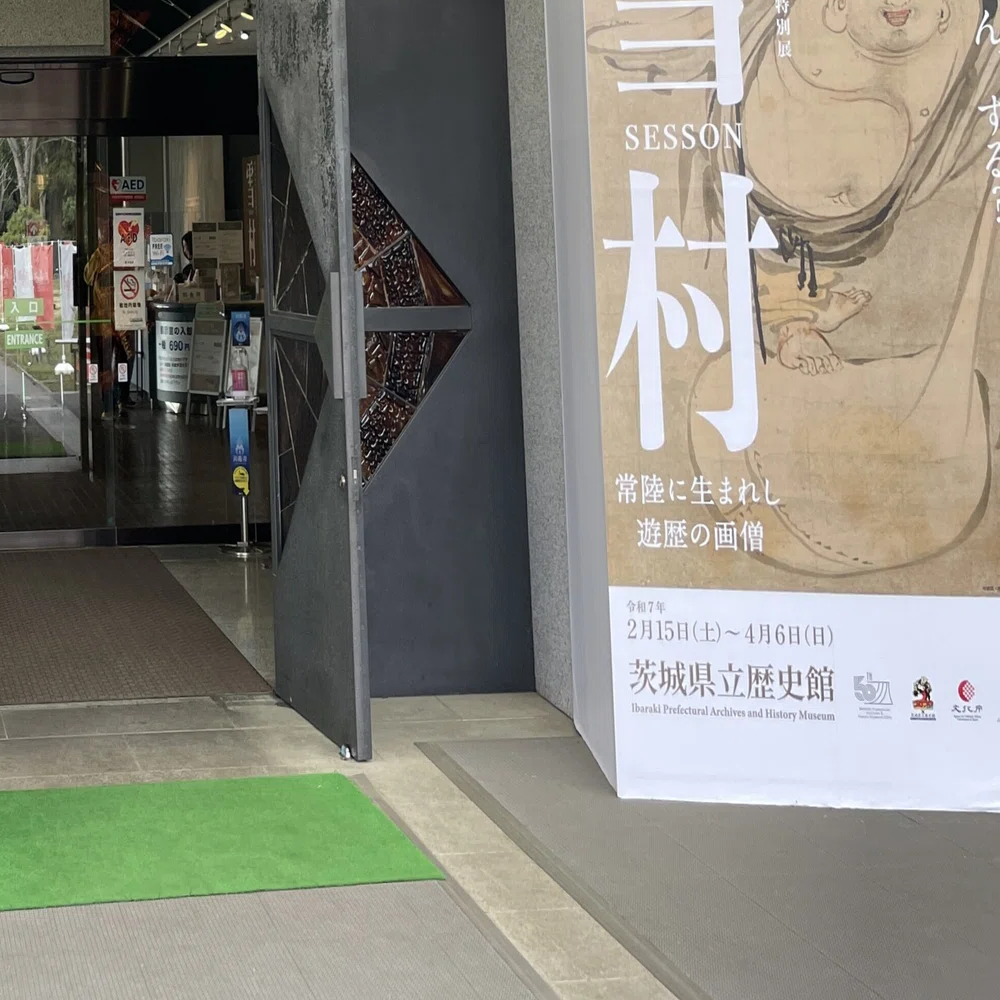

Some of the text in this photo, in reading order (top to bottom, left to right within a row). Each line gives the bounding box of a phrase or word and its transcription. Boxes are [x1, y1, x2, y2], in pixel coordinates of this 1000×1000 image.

[625, 123, 743, 151] SESSON
[122, 179, 145, 190] AED
[10, 301, 38, 314] 入口
[6, 333, 43, 346] ENTRANCE
[615, 472, 781, 506] 常陸に生まれし
[636, 517, 764, 552] 遊歴の画僧
[626, 599, 666, 615] 令和7年
[629, 658, 835, 703] 茨城県立歴史館
[631, 702, 835, 722] Ibaraki Prefectural Archives and History Museum
